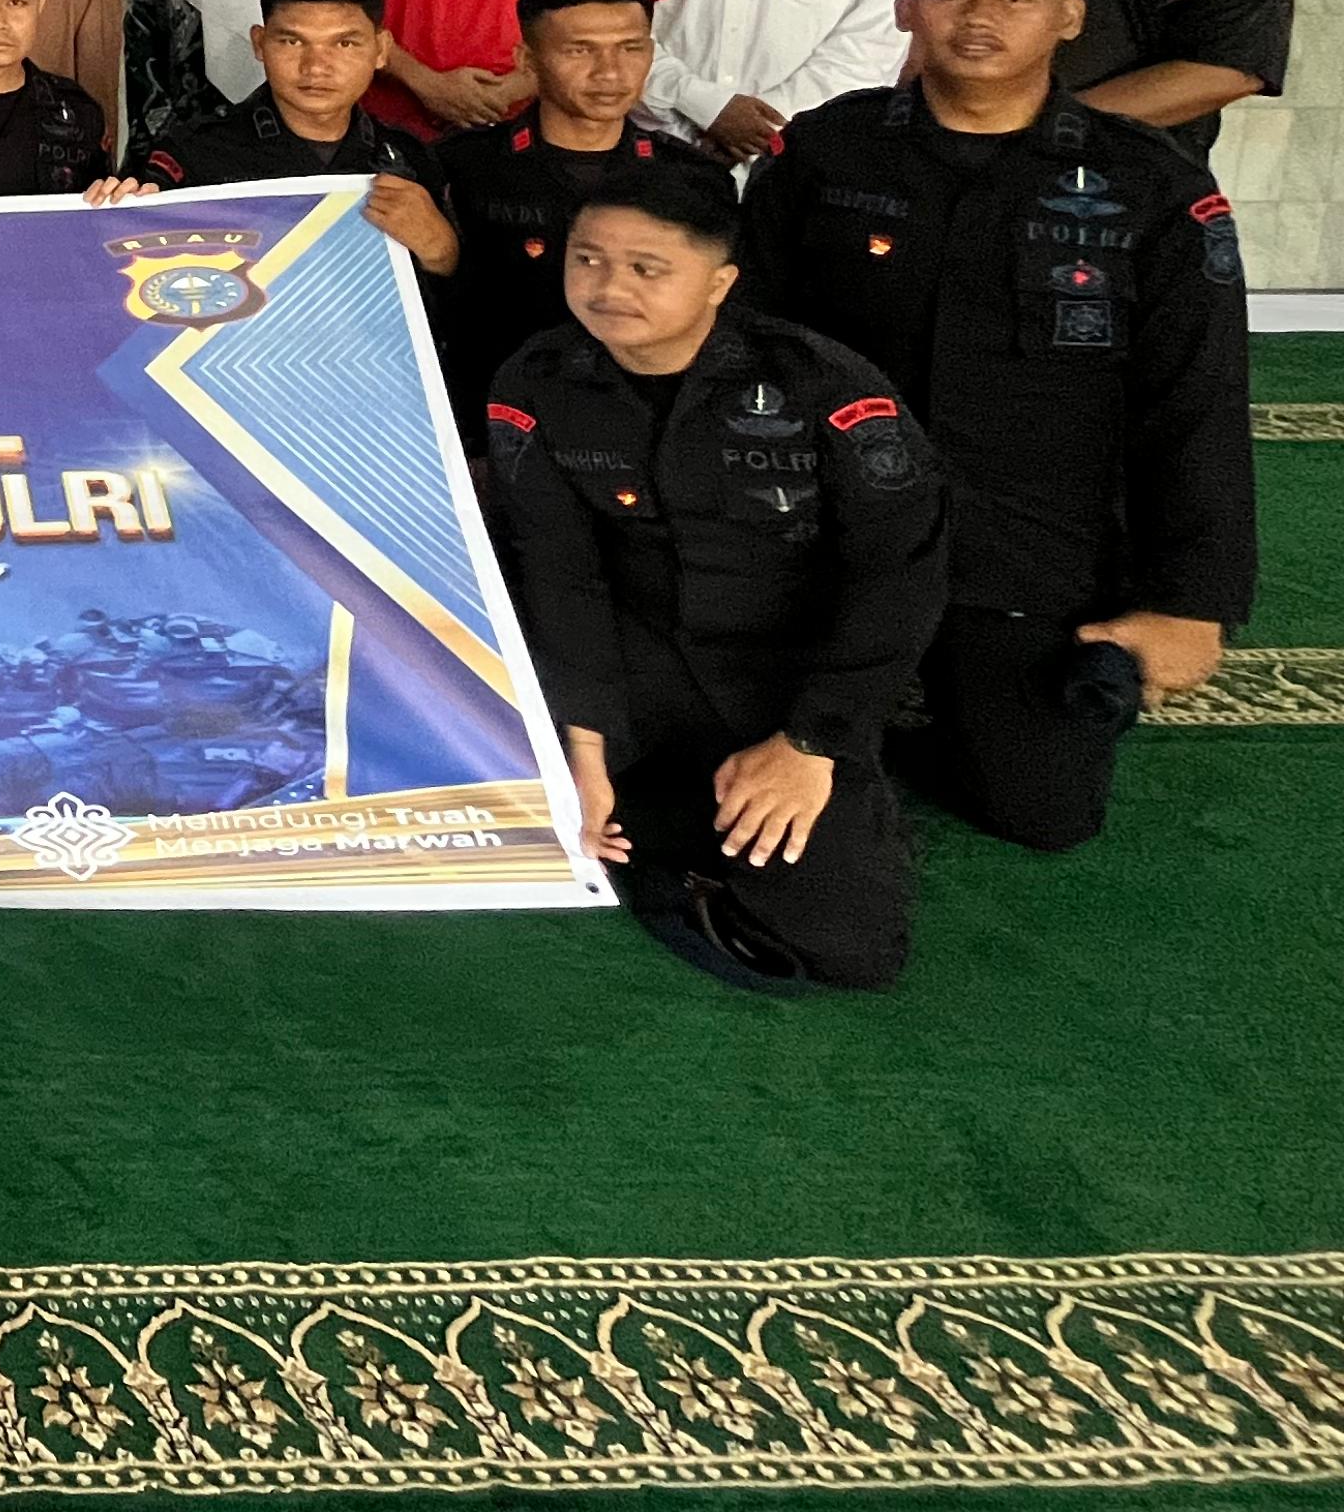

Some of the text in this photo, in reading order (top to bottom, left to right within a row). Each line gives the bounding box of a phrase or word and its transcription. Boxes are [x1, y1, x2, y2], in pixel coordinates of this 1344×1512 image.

[123, 233, 243, 251] RIAU
[146, 805, 496, 833] Melindungi Tuah
[154, 828, 503, 859] Menjaga Marwah
